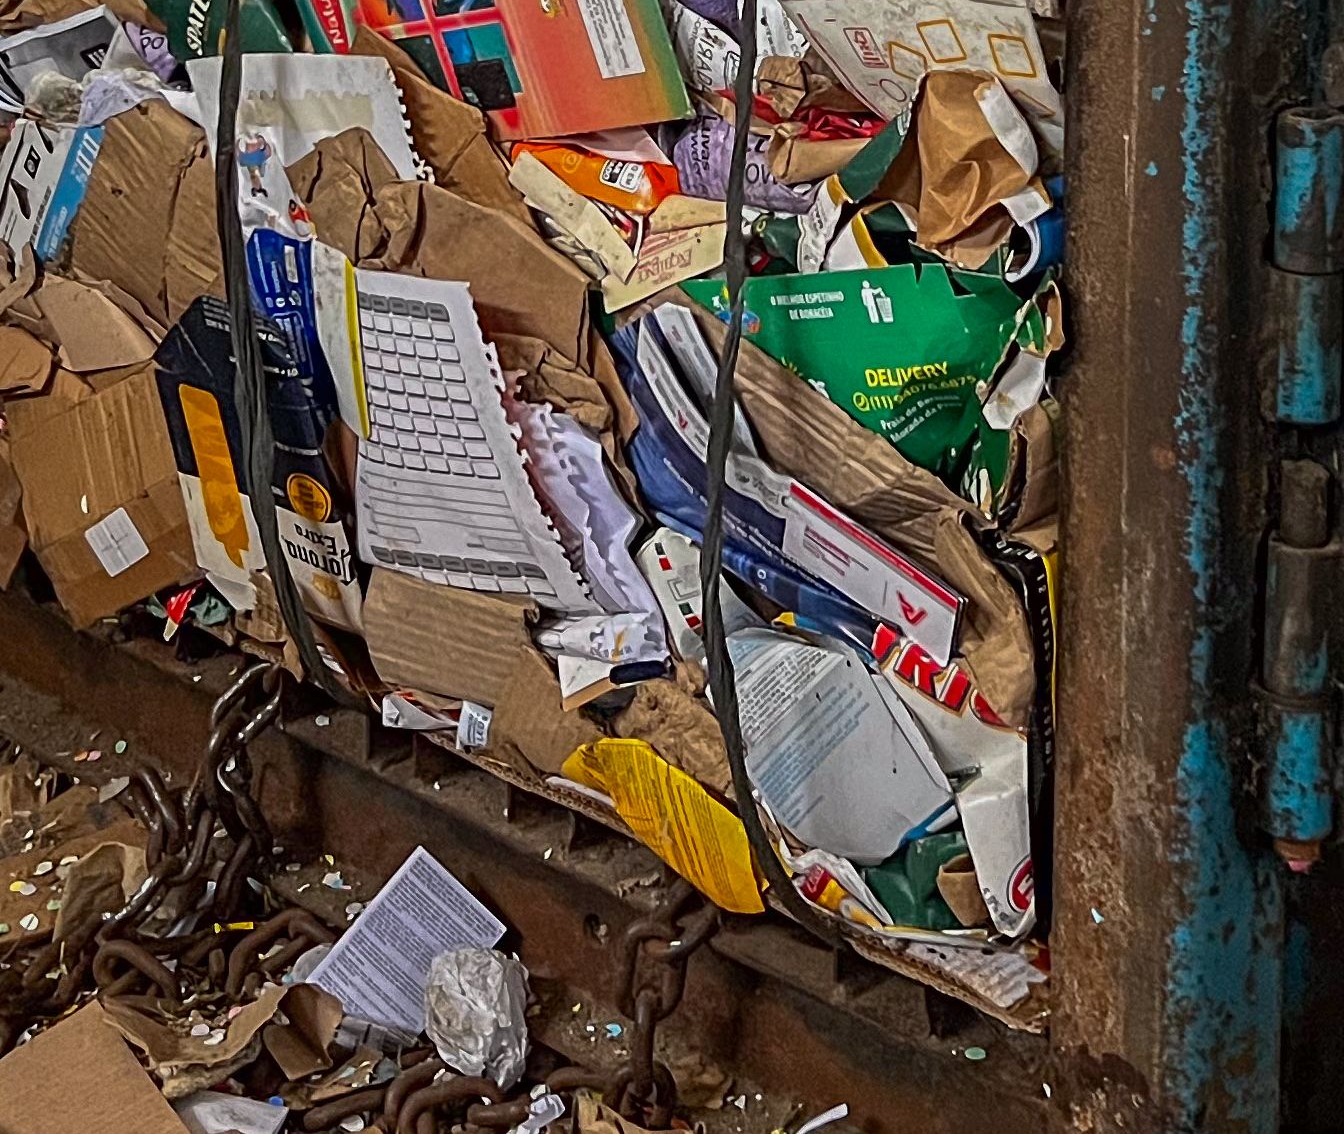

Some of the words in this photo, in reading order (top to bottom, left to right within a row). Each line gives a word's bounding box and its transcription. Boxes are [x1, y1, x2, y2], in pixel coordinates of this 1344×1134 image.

[701, 116, 718, 171] Luvas
[865, 361, 947, 387] DELIVERY
[294, 522, 338, 556] Extra
[284, 538, 356, 586] Corona
